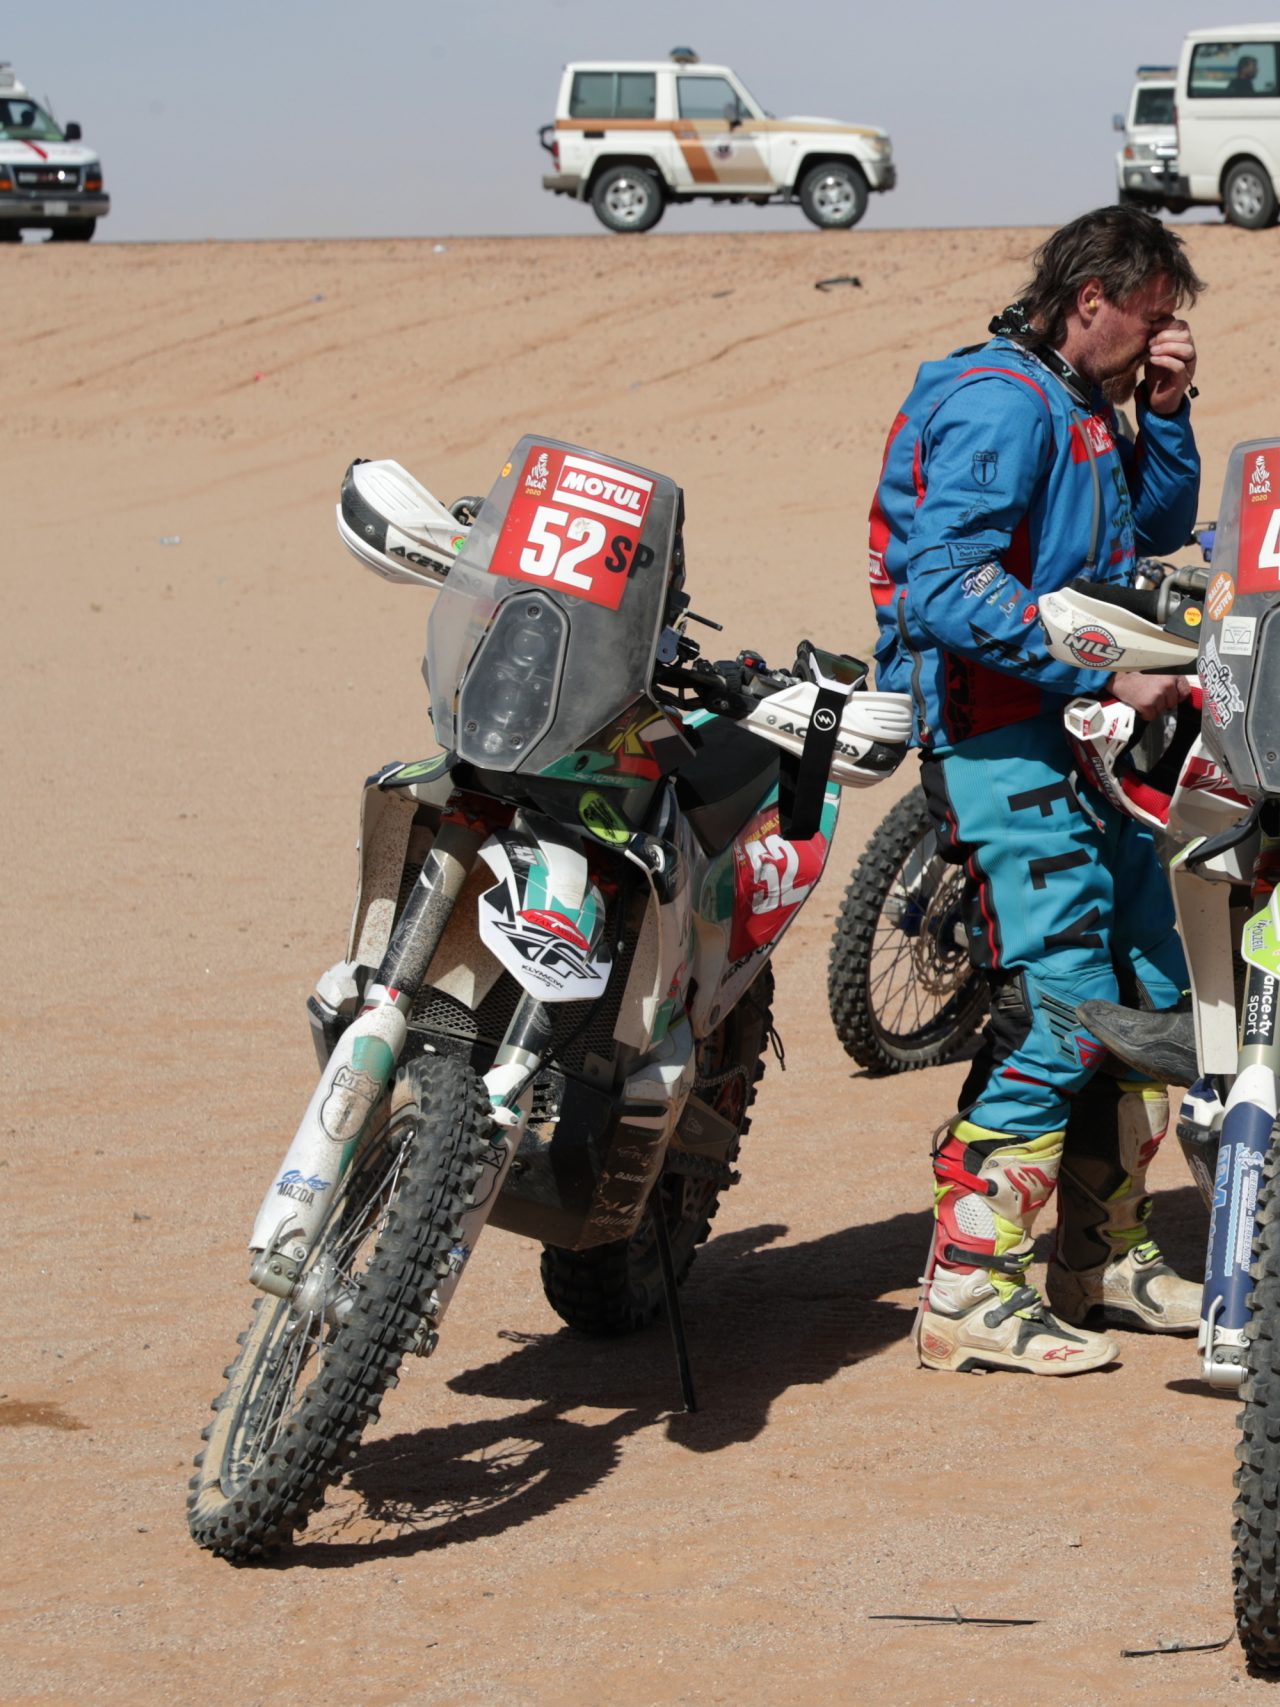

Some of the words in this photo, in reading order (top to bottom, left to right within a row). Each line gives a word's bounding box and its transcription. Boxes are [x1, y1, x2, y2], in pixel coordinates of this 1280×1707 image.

[525, 475, 548, 491] DAKAR
[525, 488, 542, 497] 2020
[561, 471, 641, 511] MOTUL
[1249, 481, 1272, 495] DAKAR
[1251, 494, 1268, 503] 2020
[389, 545, 452, 577] ACERB
[519, 505, 607, 591] 52
[604, 535, 655, 579] SP
[971, 563, 999, 597] MAZDA
[1063, 632, 1125, 662] NILS
[1207, 661, 1232, 704] EDWIN
[744, 833, 813, 916] 52
[1007, 779, 1105, 951] FLY
[1247, 994, 1260, 1035] sport
[336, 1069, 381, 1100] MEX
[276, 1182, 316, 1207] MAZDA
